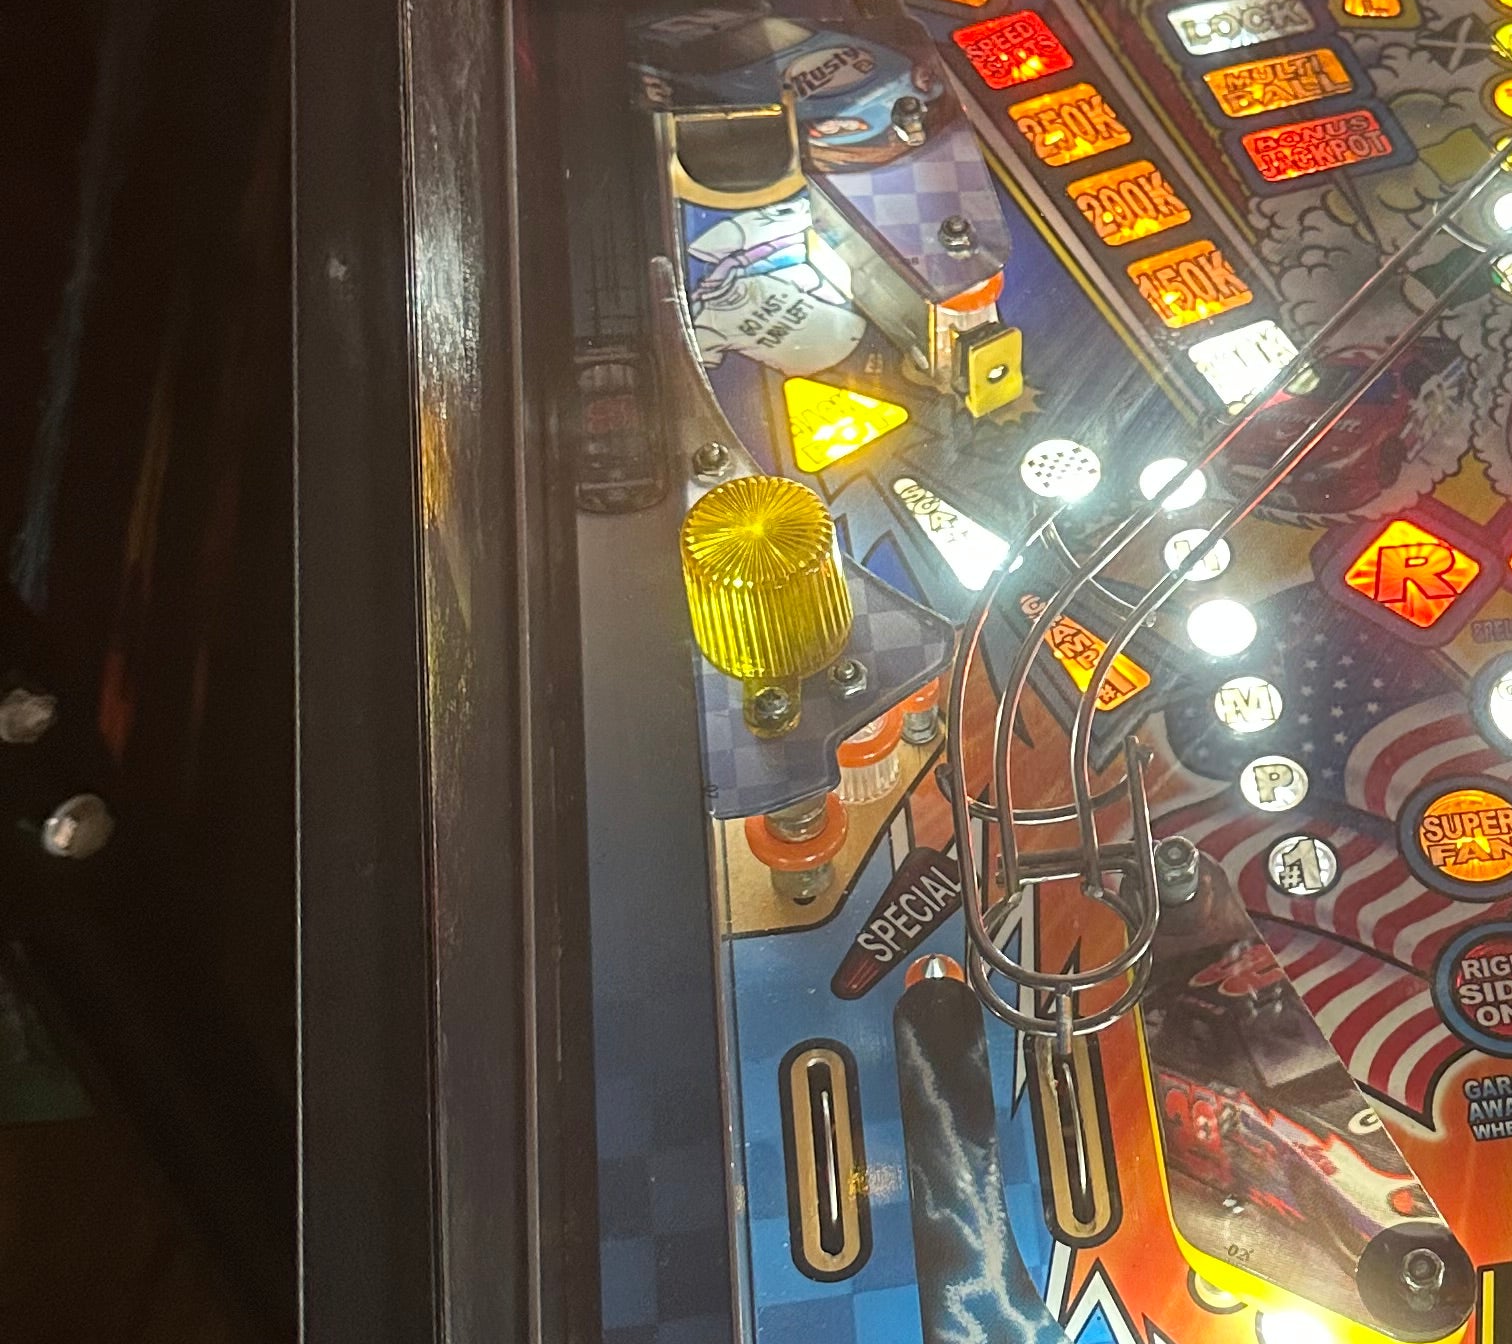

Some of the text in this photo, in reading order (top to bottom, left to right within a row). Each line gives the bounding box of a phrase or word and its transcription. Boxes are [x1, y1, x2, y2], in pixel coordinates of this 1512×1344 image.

[965, 20, 1034, 61] SPEED
[1224, 55, 1319, 92] MULTI
[1017, 94, 1125, 159] 250K
[1254, 114, 1370, 146] BONUS
[1261, 131, 1386, 178] JACKPOT
[1075, 170, 1184, 236] 200K
[1137, 249, 1248, 318] 150K
[1374, 542, 1458, 602] R
[1221, 684, 1274, 723] M
[1253, 763, 1294, 803] P
[1279, 838, 1325, 891] #1
[857, 866, 962, 964] SPECIAL
